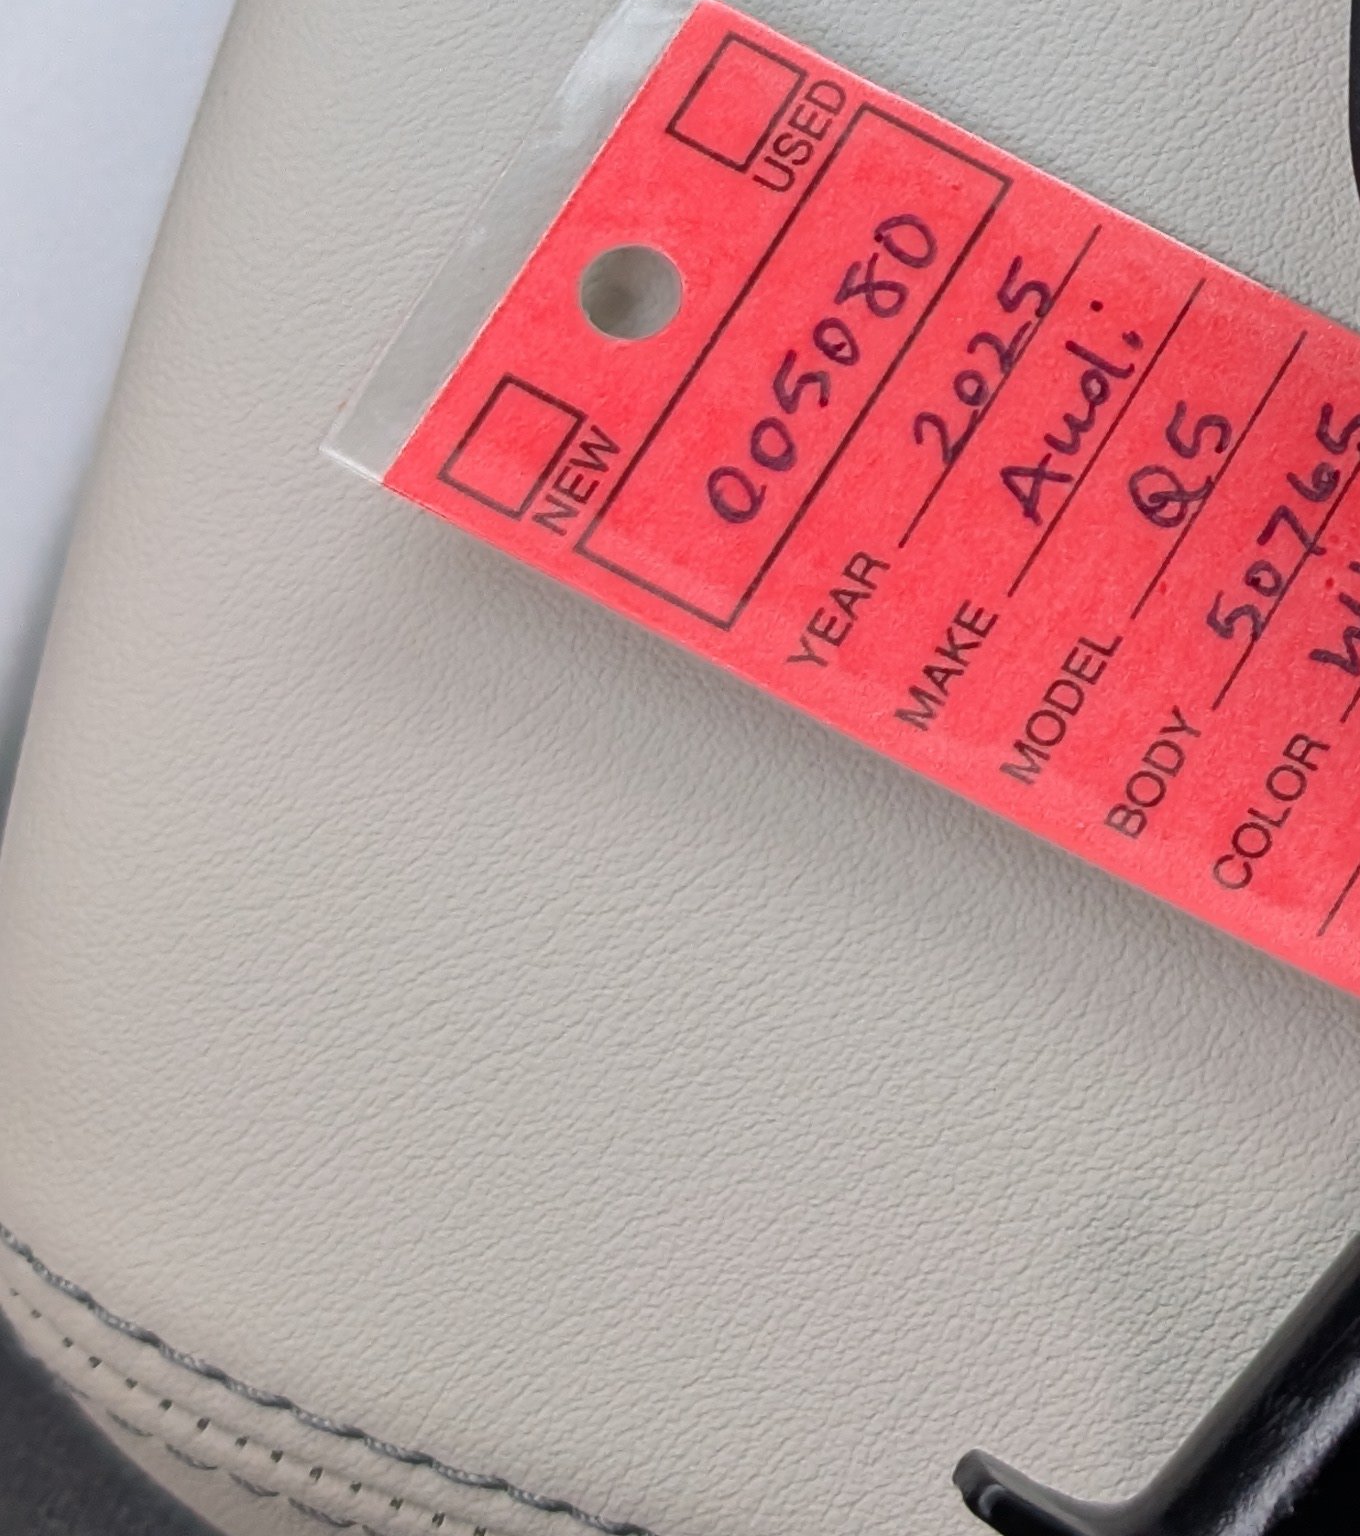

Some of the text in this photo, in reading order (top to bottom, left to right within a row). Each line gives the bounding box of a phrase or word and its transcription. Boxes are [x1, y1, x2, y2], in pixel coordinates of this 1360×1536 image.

[752, 77, 848, 194] USED
[706, 214, 939, 524] 005080
[913, 255, 1054, 466] 2025
[1000, 299, 1144, 526] Audi
[532, 426, 622, 536] NEW
[1128, 399, 1232, 528] Q5
[787, 550, 891, 667] YEAR
[894, 599, 998, 730] MAKE
[1000, 634, 1123, 786] MODEL
[1105, 706, 1203, 839] BODY
[1211, 732, 1330, 891] COLOR
